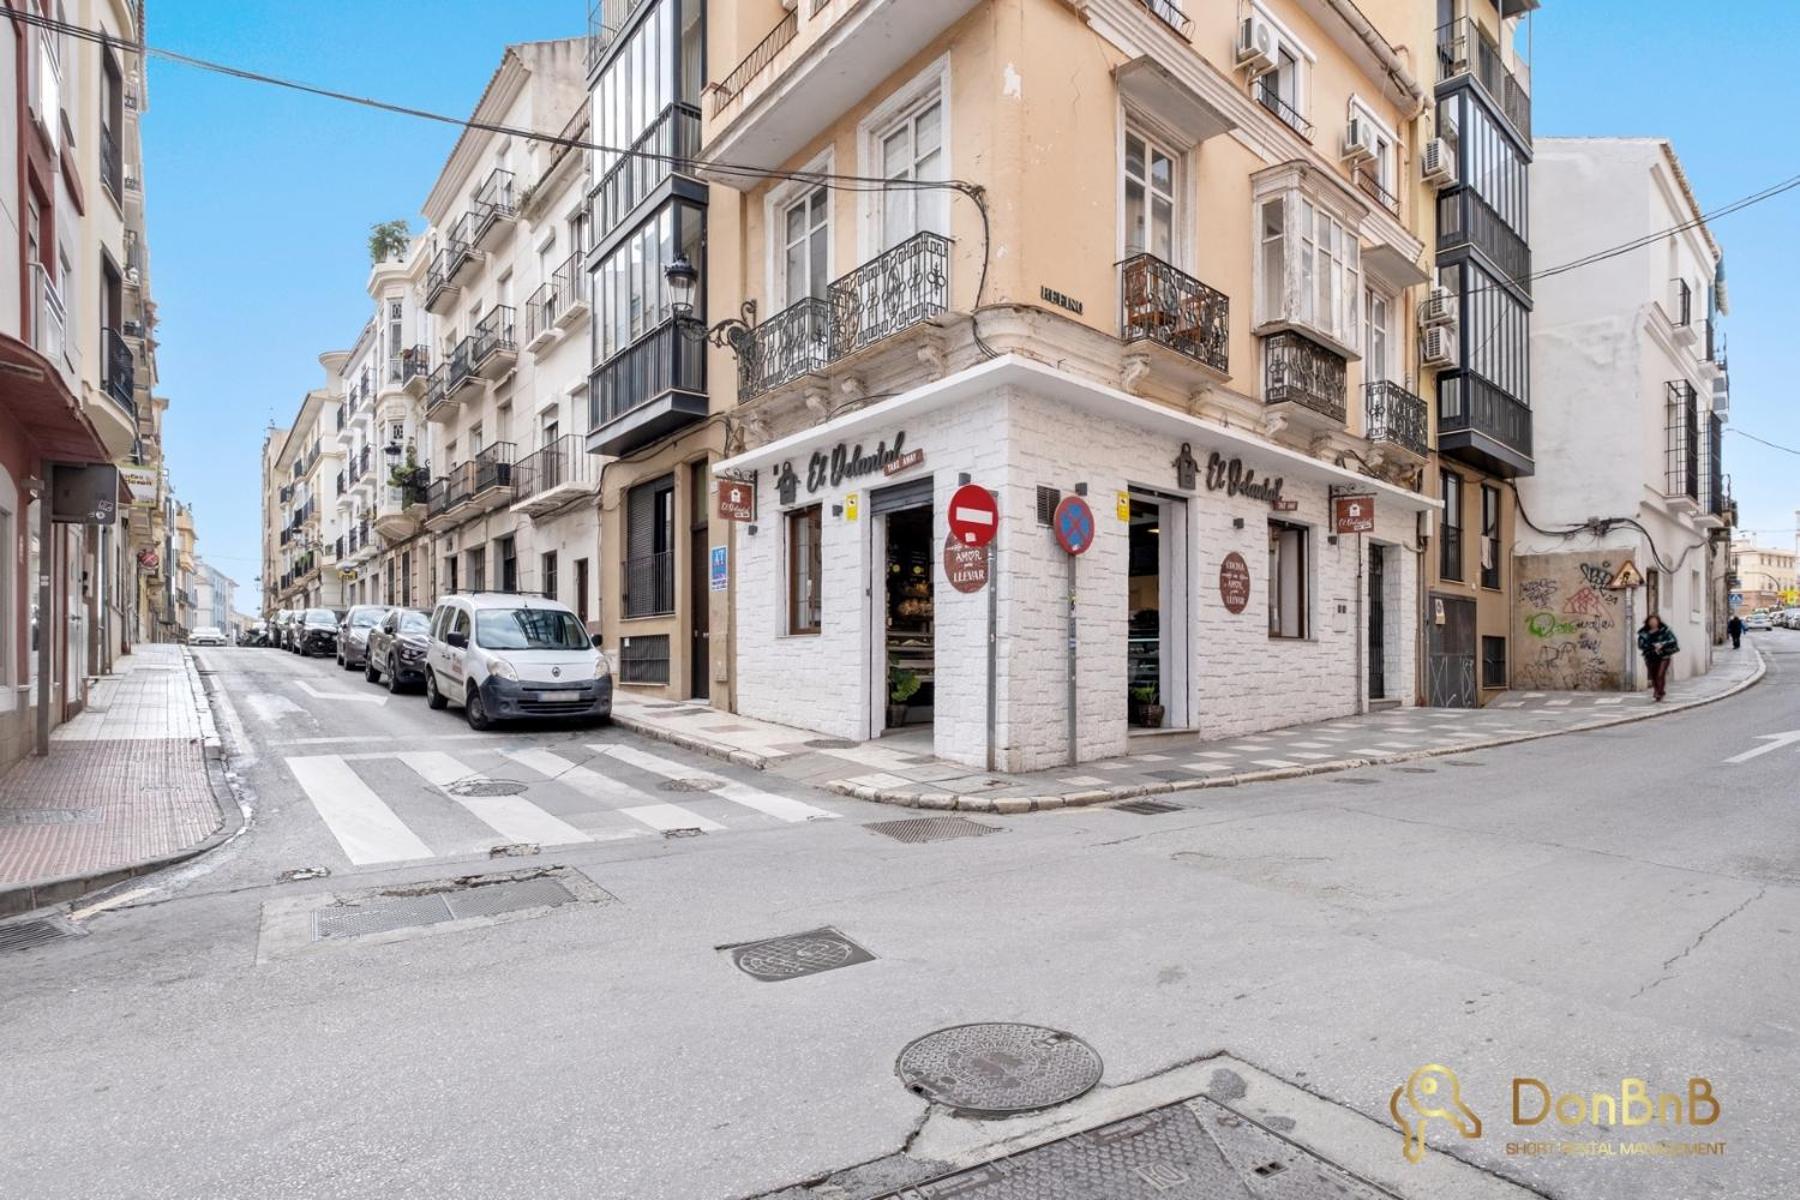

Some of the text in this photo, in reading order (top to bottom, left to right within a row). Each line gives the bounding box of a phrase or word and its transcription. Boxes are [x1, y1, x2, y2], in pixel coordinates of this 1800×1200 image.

[807, 451, 829, 493] El
[1207, 452, 1226, 491] El
[953, 570, 985, 583] LLEVAR
